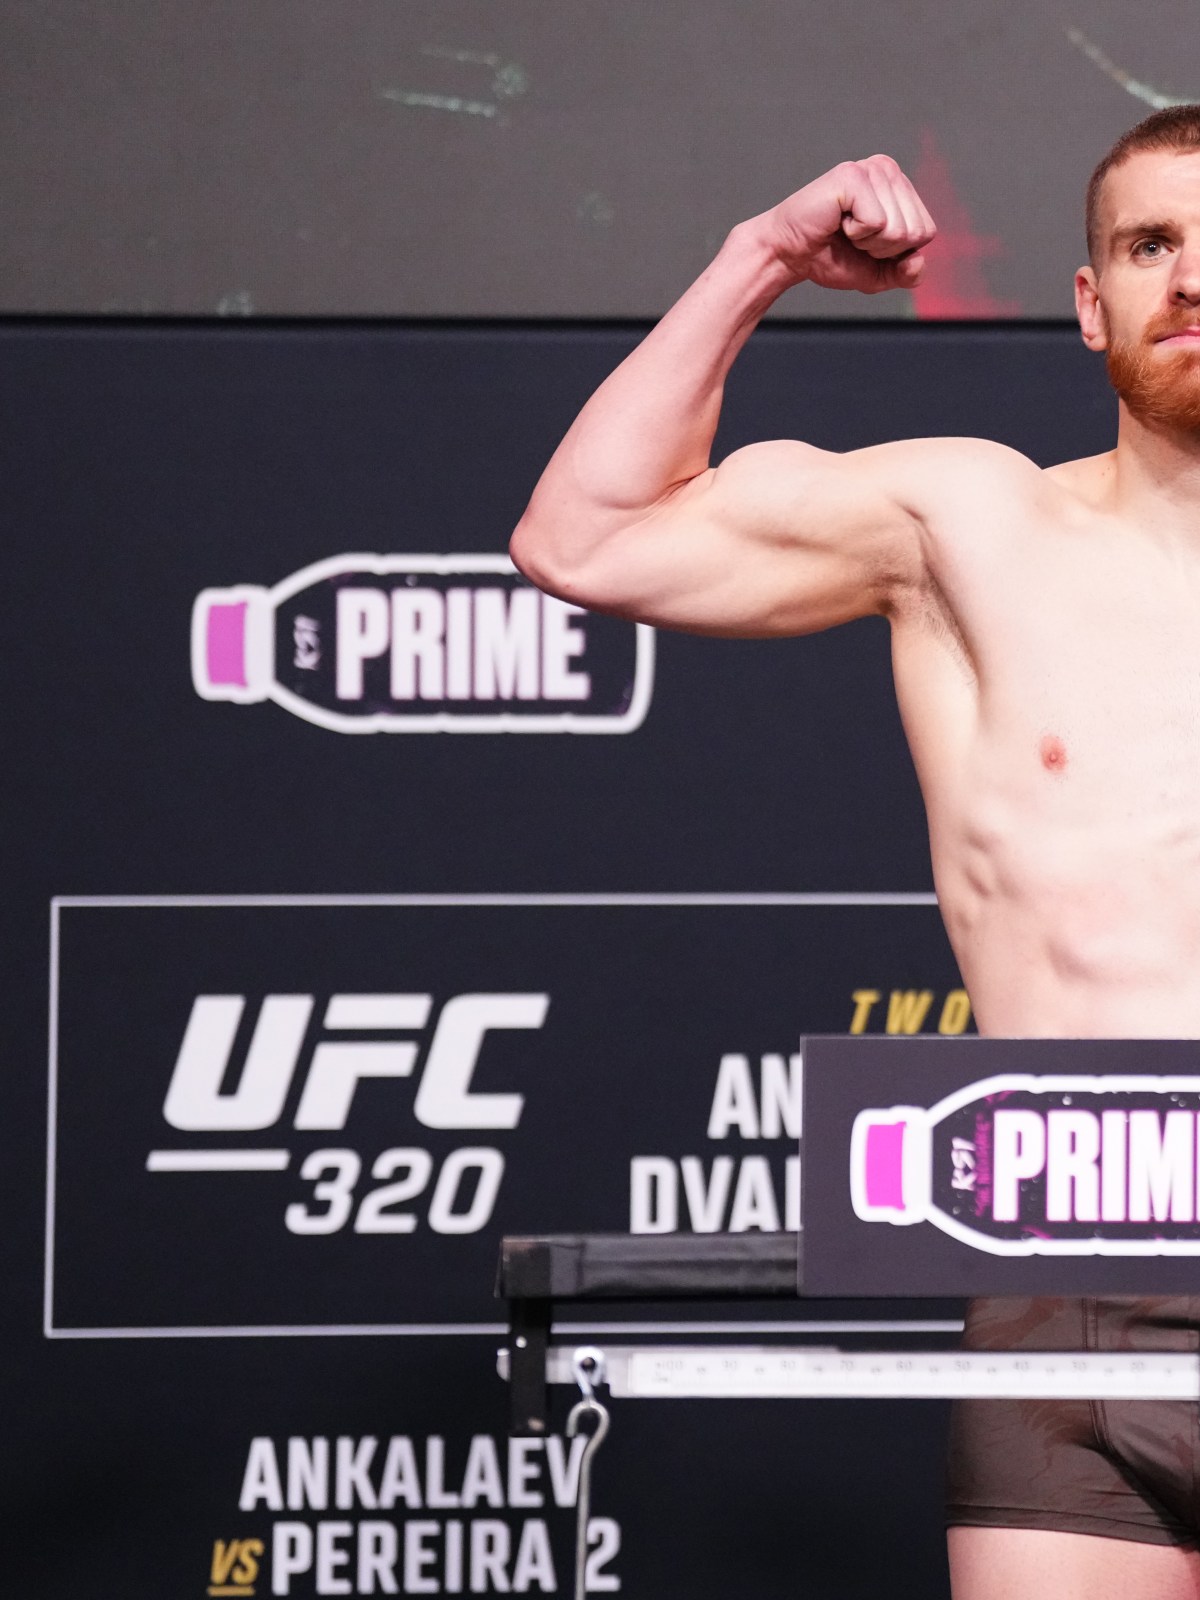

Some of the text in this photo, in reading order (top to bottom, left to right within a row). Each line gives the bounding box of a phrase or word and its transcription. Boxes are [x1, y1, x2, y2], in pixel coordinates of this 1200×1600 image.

[336, 588, 590, 701] PRIME
[850, 989, 971, 1035] TWO
[163, 993, 550, 1131] UFC
[286, 1147, 503, 1236] 320
[951, 1137, 977, 1192] KSI
[239, 1434, 592, 1511] ANKALAEV
[272, 1519, 557, 1596] PEREIRA
[585, 1518, 622, 1592] 2
